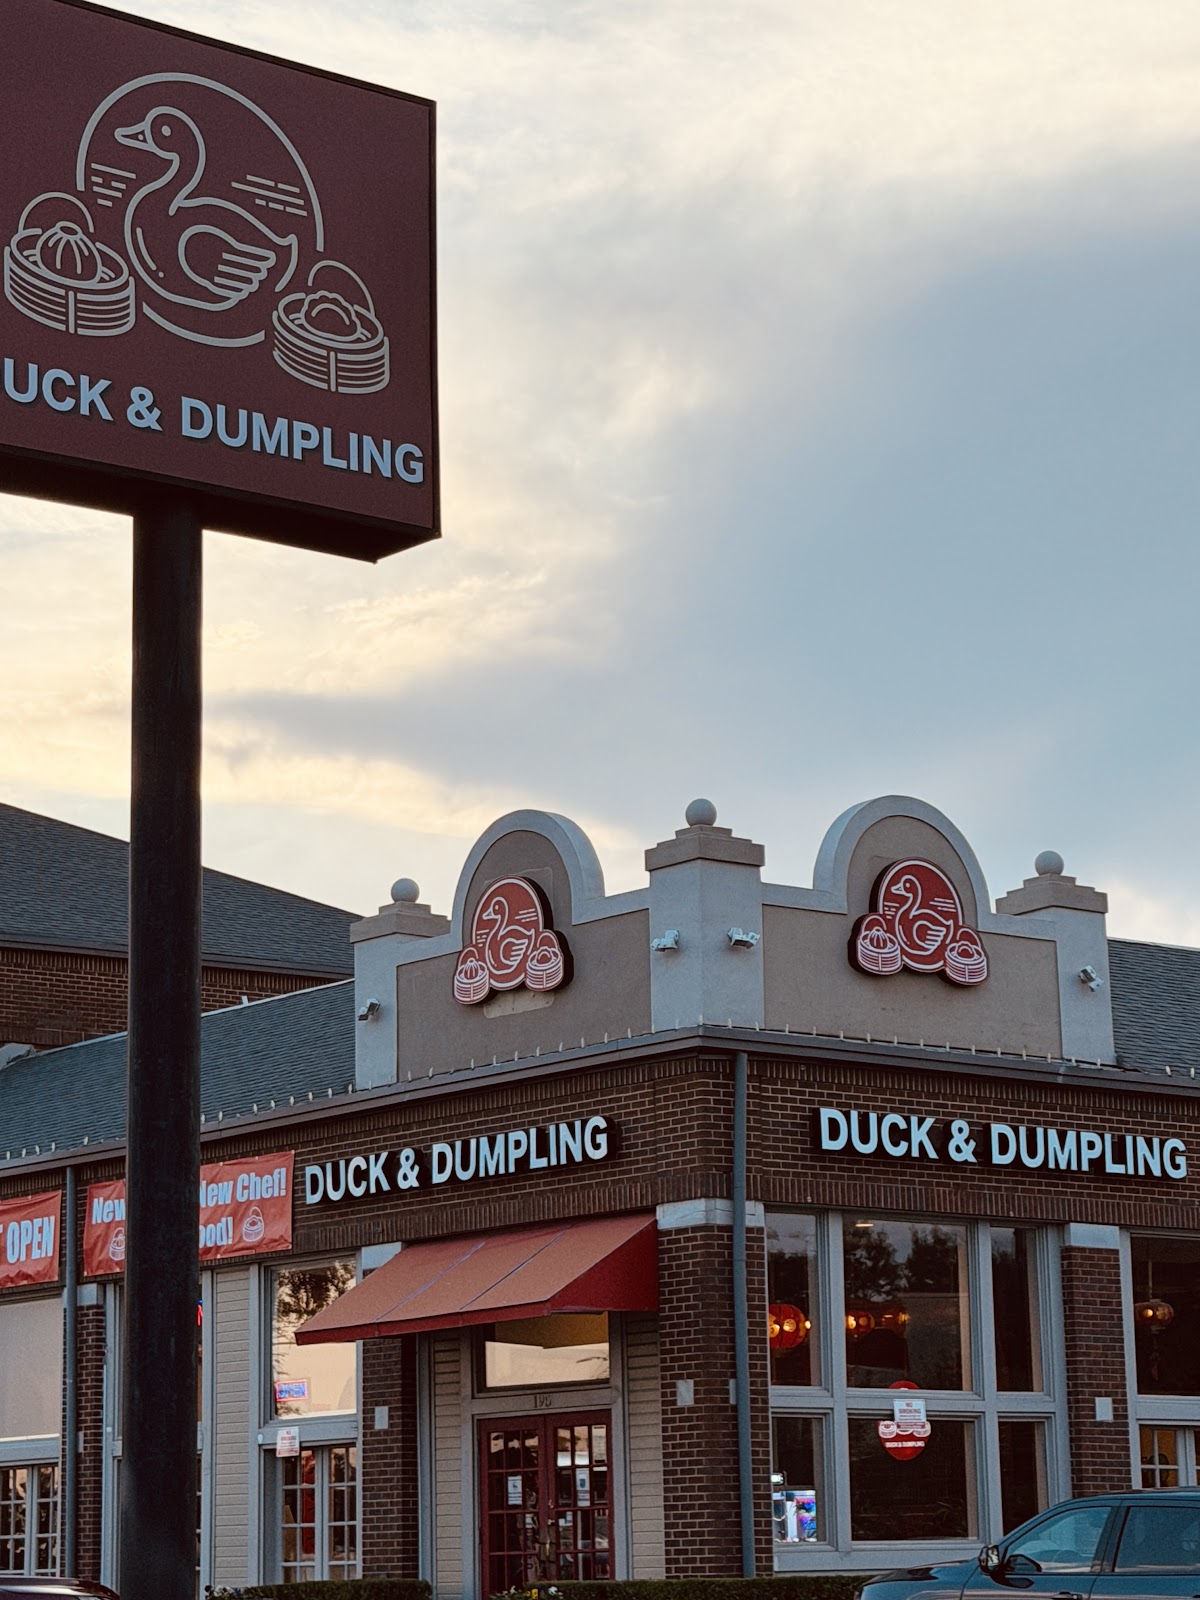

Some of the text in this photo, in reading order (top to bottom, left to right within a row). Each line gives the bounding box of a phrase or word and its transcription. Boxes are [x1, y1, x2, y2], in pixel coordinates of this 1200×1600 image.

[3, 357, 425, 484] UCK & DUMPLING
[305, 1115, 608, 1205] DUCK & DUMPLING
[819, 1107, 1188, 1180] DUCK & DUMPLING
[92, 1197, 126, 1225] New
[236, 1167, 287, 1203] Chef!
[6, 1215, 56, 1264] OPEN
[199, 1216, 233, 1249] ood!
